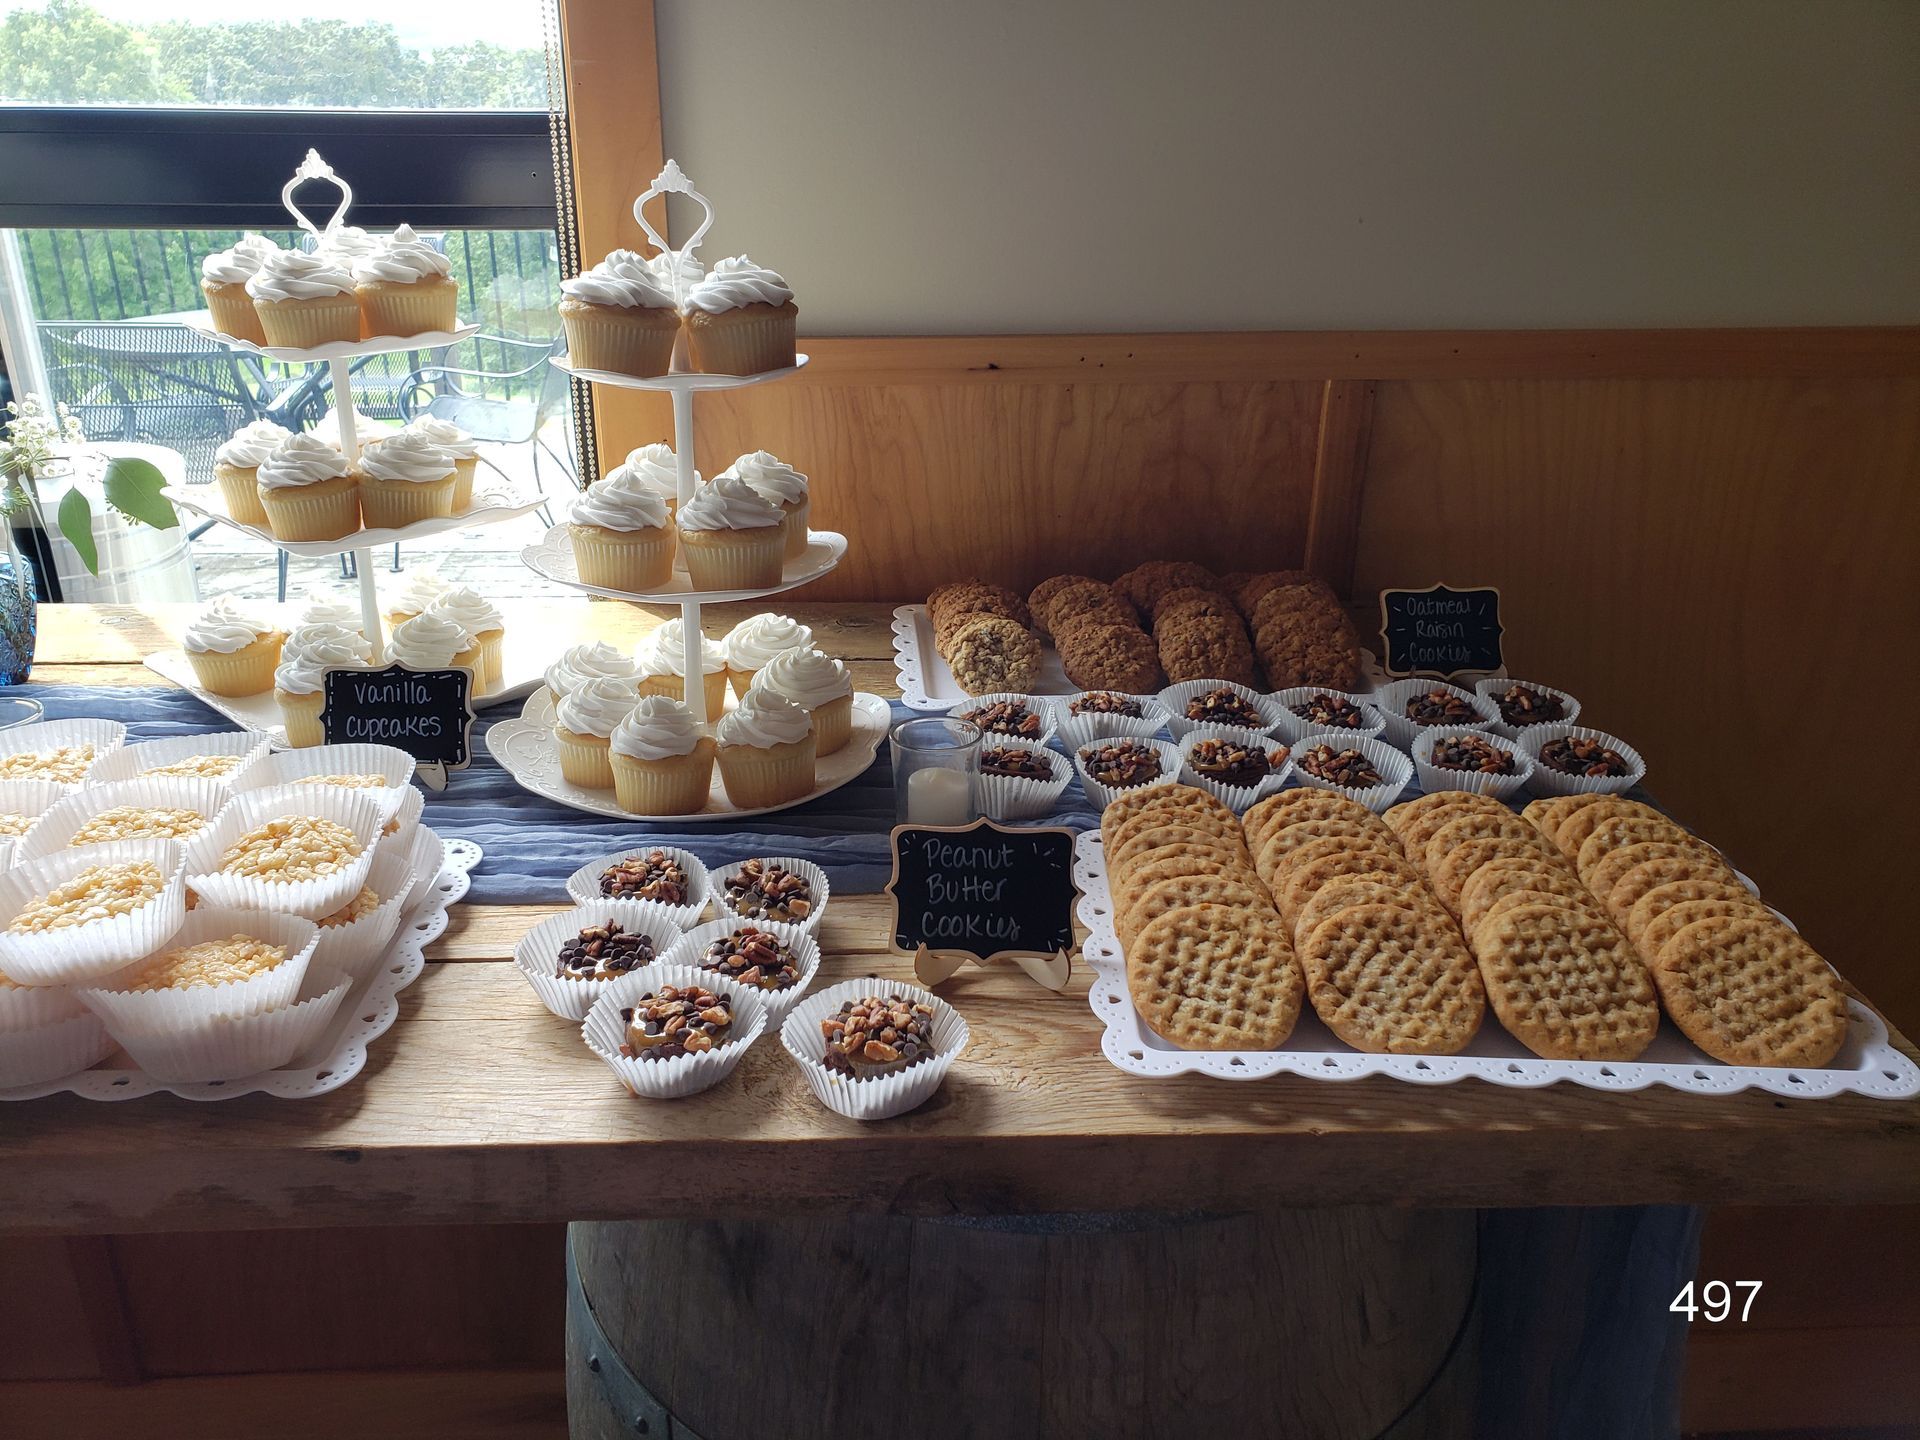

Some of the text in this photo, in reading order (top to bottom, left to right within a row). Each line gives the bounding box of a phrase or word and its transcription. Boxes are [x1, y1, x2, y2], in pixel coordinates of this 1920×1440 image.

[1406, 597, 1471, 616] Oatmeal
[1416, 619, 1465, 639] Raisin
[1409, 642, 1471, 663] Cookies
[922, 838, 1015, 869] Peanut
[926, 873, 1008, 904] Butter
[921, 911, 1021, 942] Cookies
